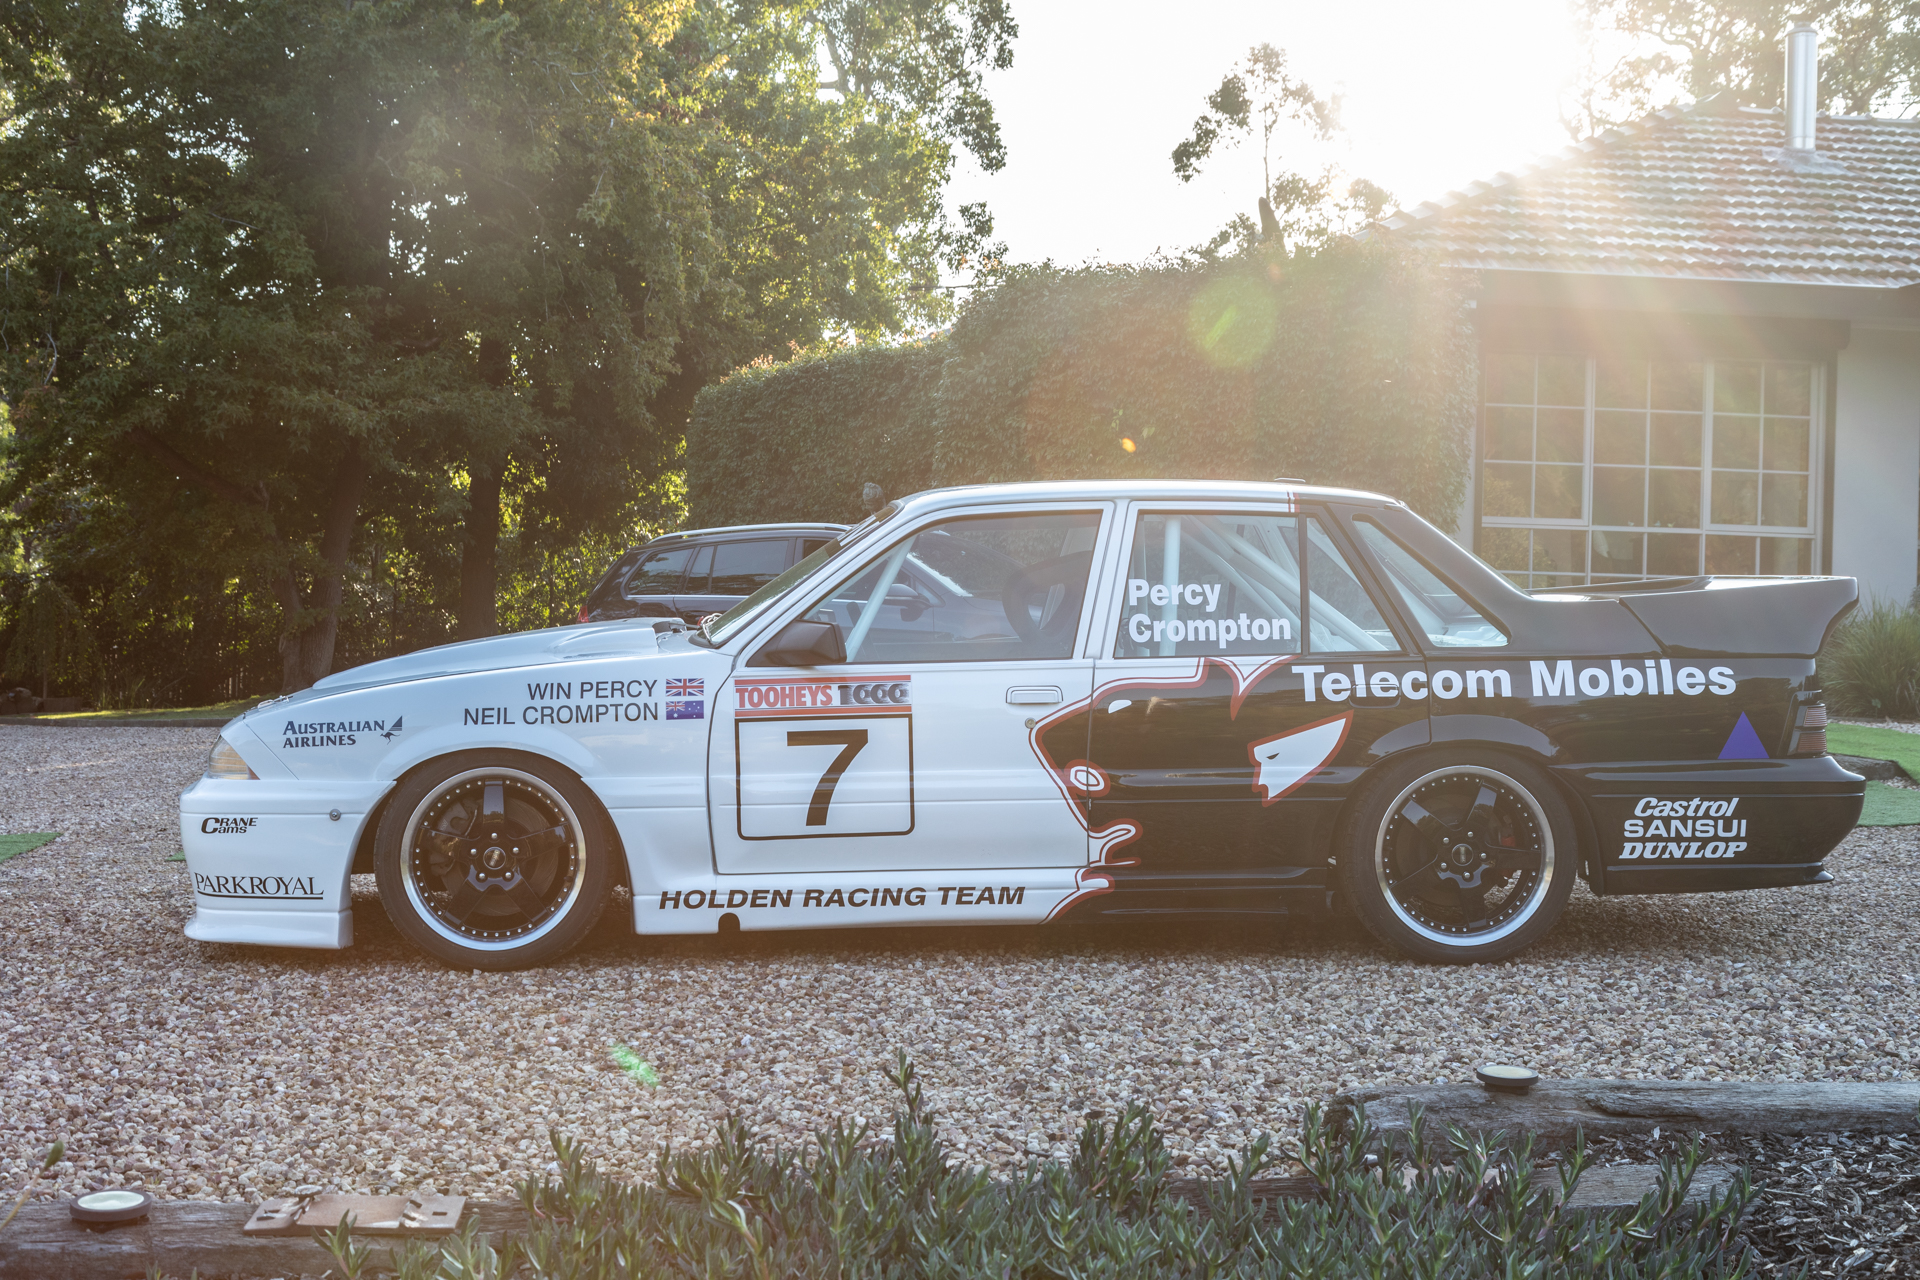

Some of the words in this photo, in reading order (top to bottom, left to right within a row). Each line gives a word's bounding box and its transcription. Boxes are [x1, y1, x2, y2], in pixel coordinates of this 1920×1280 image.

[1128, 578, 1221, 612] Percy
[1128, 613, 1291, 649] Crompton
[527, 682, 572, 700] WIN
[580, 680, 658, 699] PERCY
[1291, 664, 1512, 702] Telecom
[1529, 659, 1738, 697] Mobiles
[735, 685, 833, 708] TOOHEYS
[838, 683, 910, 706] 1000
[463, 707, 515, 726] NEIL
[522, 702, 658, 725] CROMPTON
[282, 720, 385, 735] AUSTRALIAN
[282, 734, 356, 748] AIRLINES
[787, 729, 868, 826] 7
[1634, 797, 1740, 817] Castrol
[201, 817, 258, 834] CRANE
[1623, 819, 1747, 838] SANSUI
[1618, 841, 1748, 859] DUNLOP
[194, 871, 324, 895] PARKROYAL
[659, 889, 793, 910] HOLDEN
[803, 887, 926, 908] RACING
[937, 886, 1026, 906] TEAM
